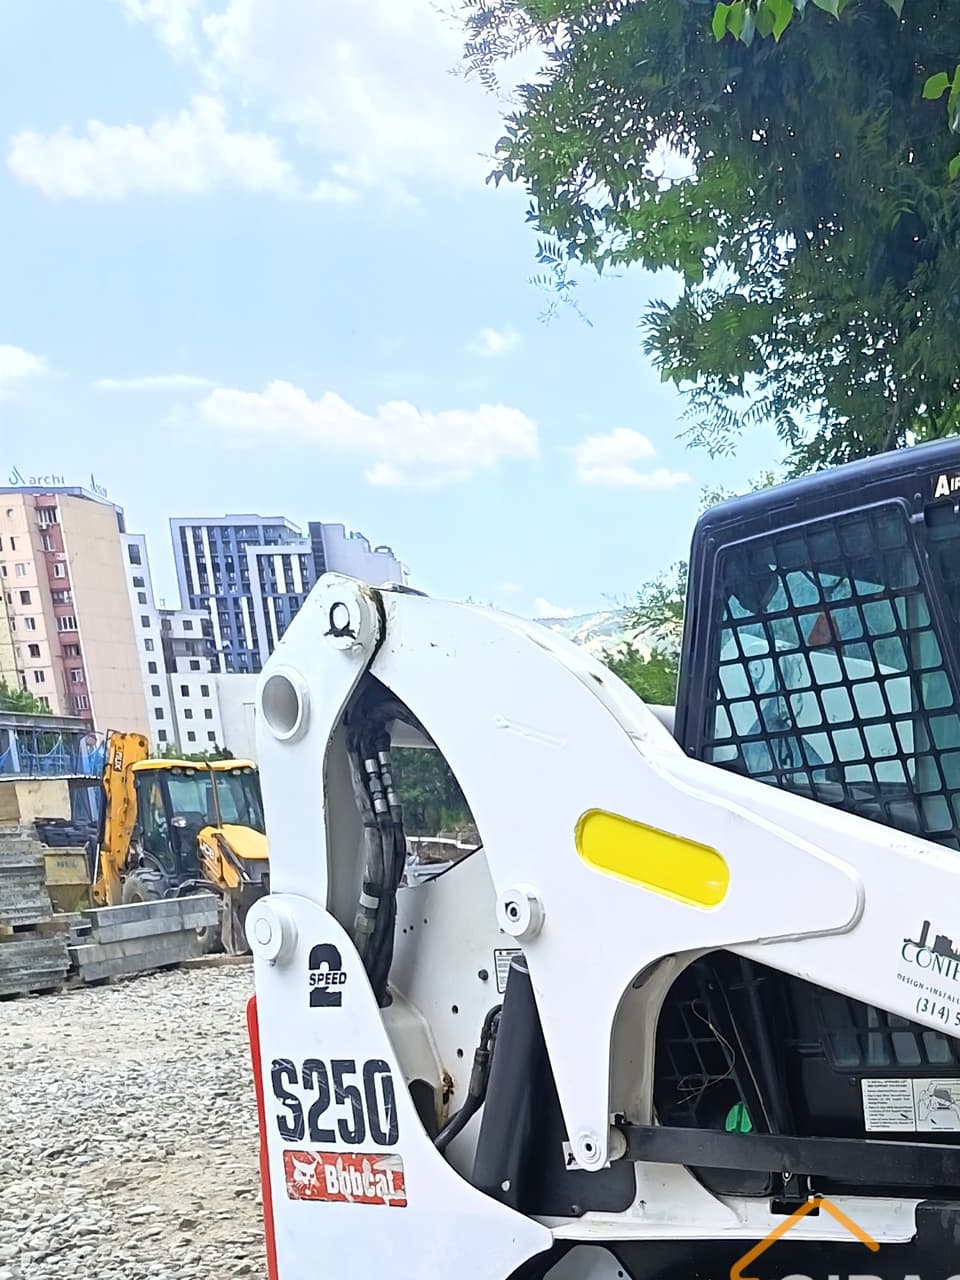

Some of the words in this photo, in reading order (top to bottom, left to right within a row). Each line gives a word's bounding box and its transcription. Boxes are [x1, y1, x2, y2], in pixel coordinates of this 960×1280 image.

[308, 943, 343, 1008] 2
[309, 970, 347, 986] SPEED
[896, 973, 924, 990] DESIGN
[916, 997, 950, 1025] (314)
[271, 1057, 400, 1146] S250
[324, 1162, 397, 1198] Bobcat
